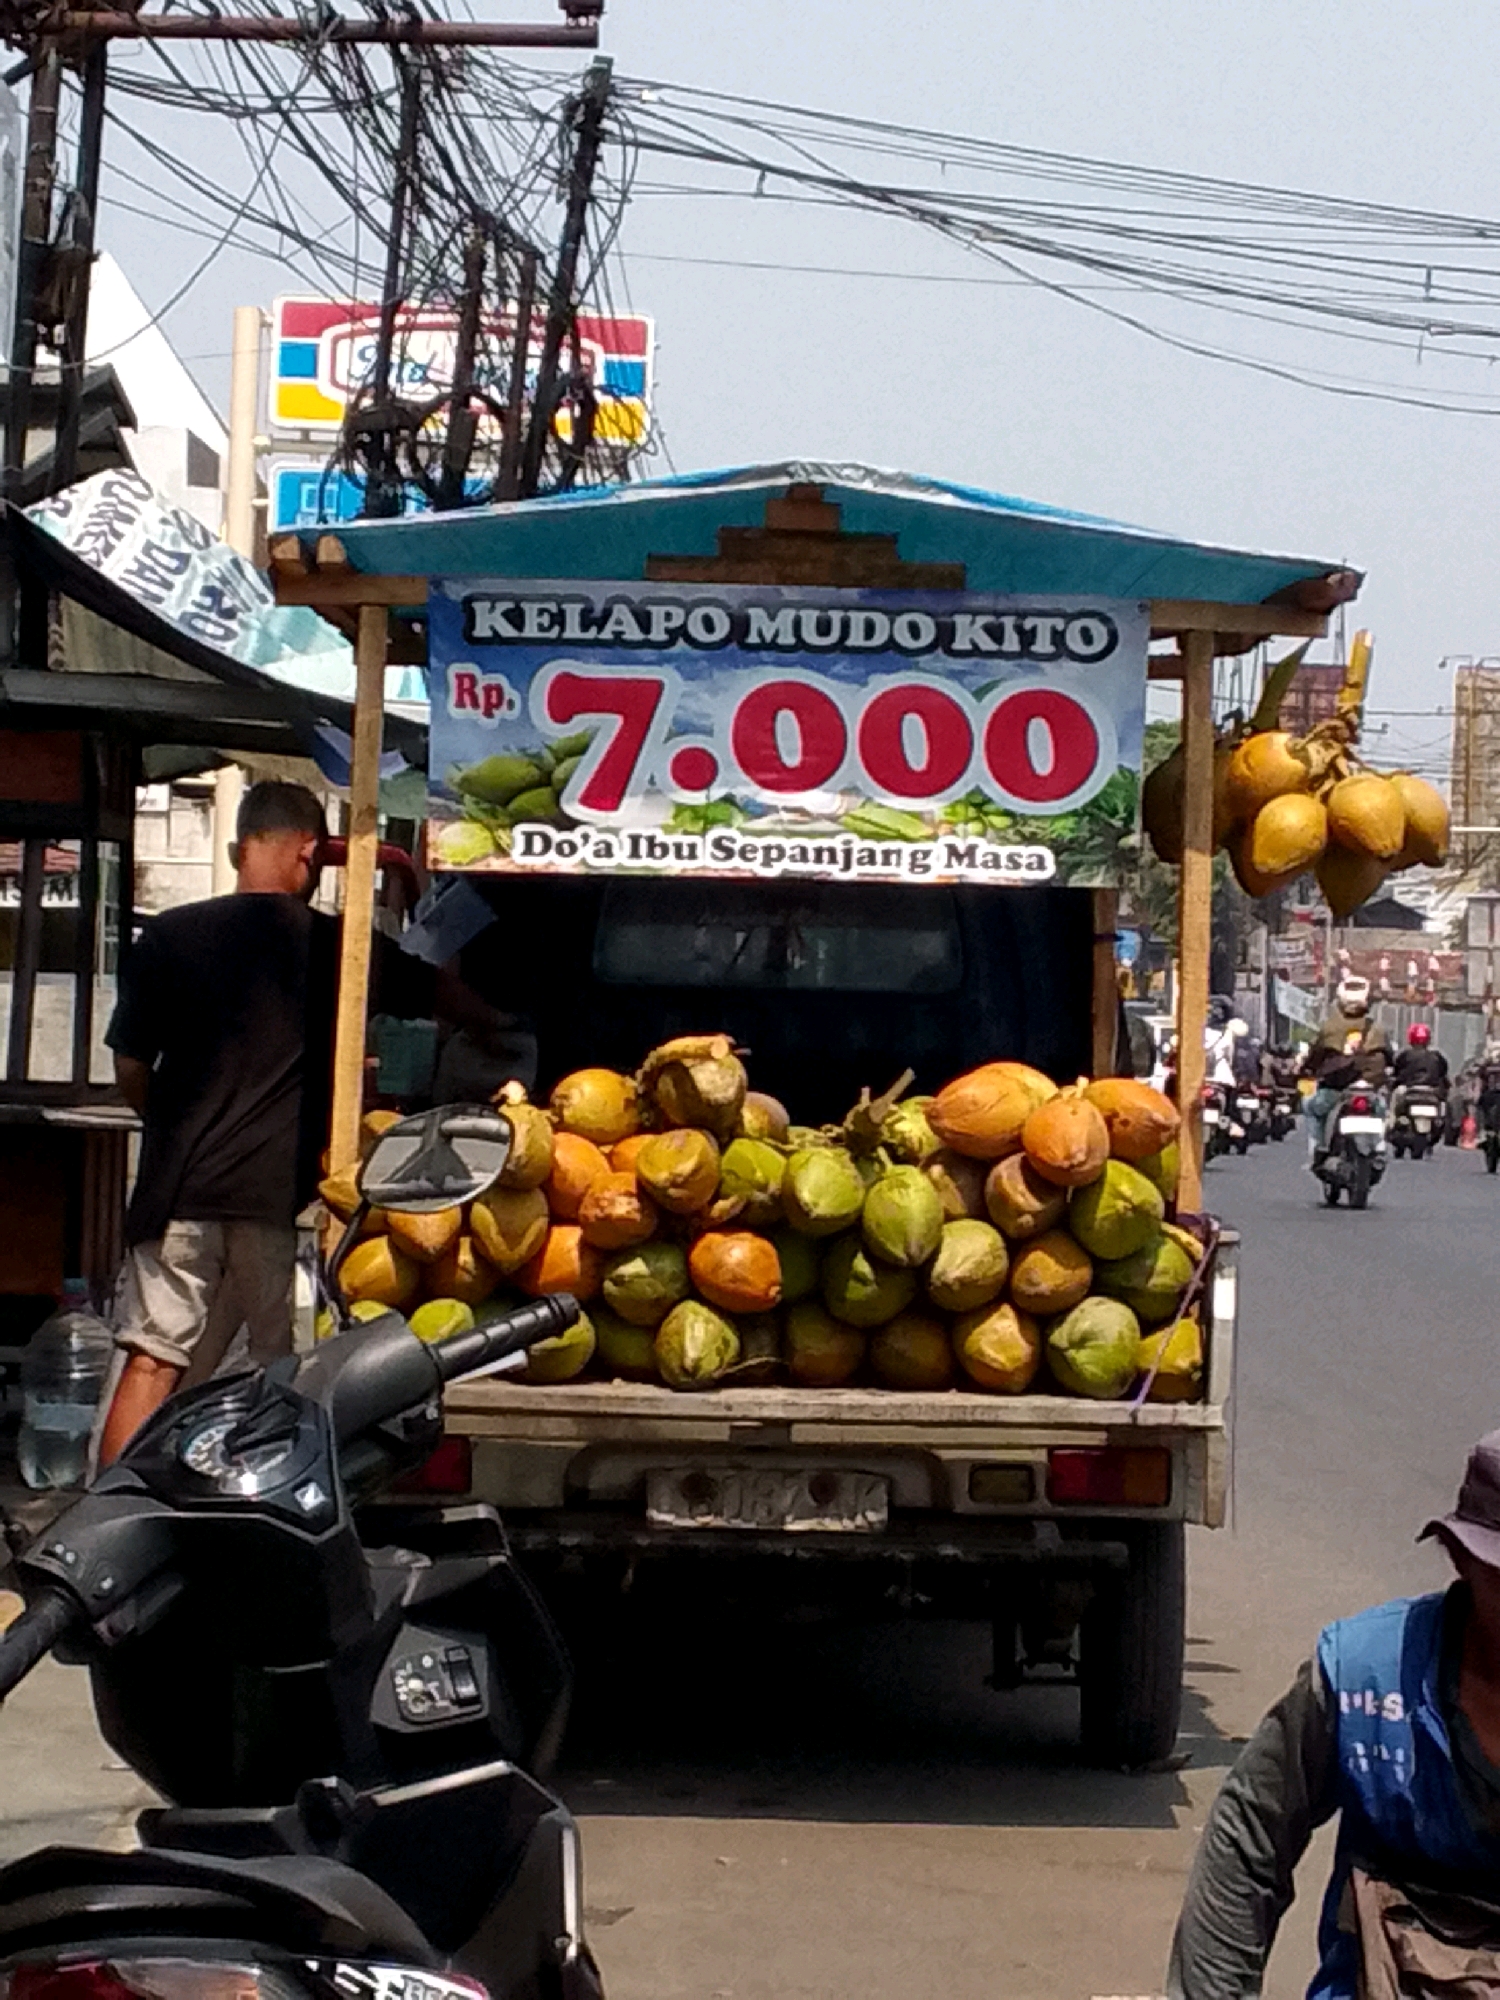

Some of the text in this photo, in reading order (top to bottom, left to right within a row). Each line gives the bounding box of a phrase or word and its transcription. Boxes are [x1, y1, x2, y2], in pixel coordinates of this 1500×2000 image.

[471, 600, 1110, 656] KELAPO MUDO KITO
[453, 671, 1100, 812] Rp. 7.000
[519, 830, 1048, 874] Do'a Ibu Sepanjang Masa
